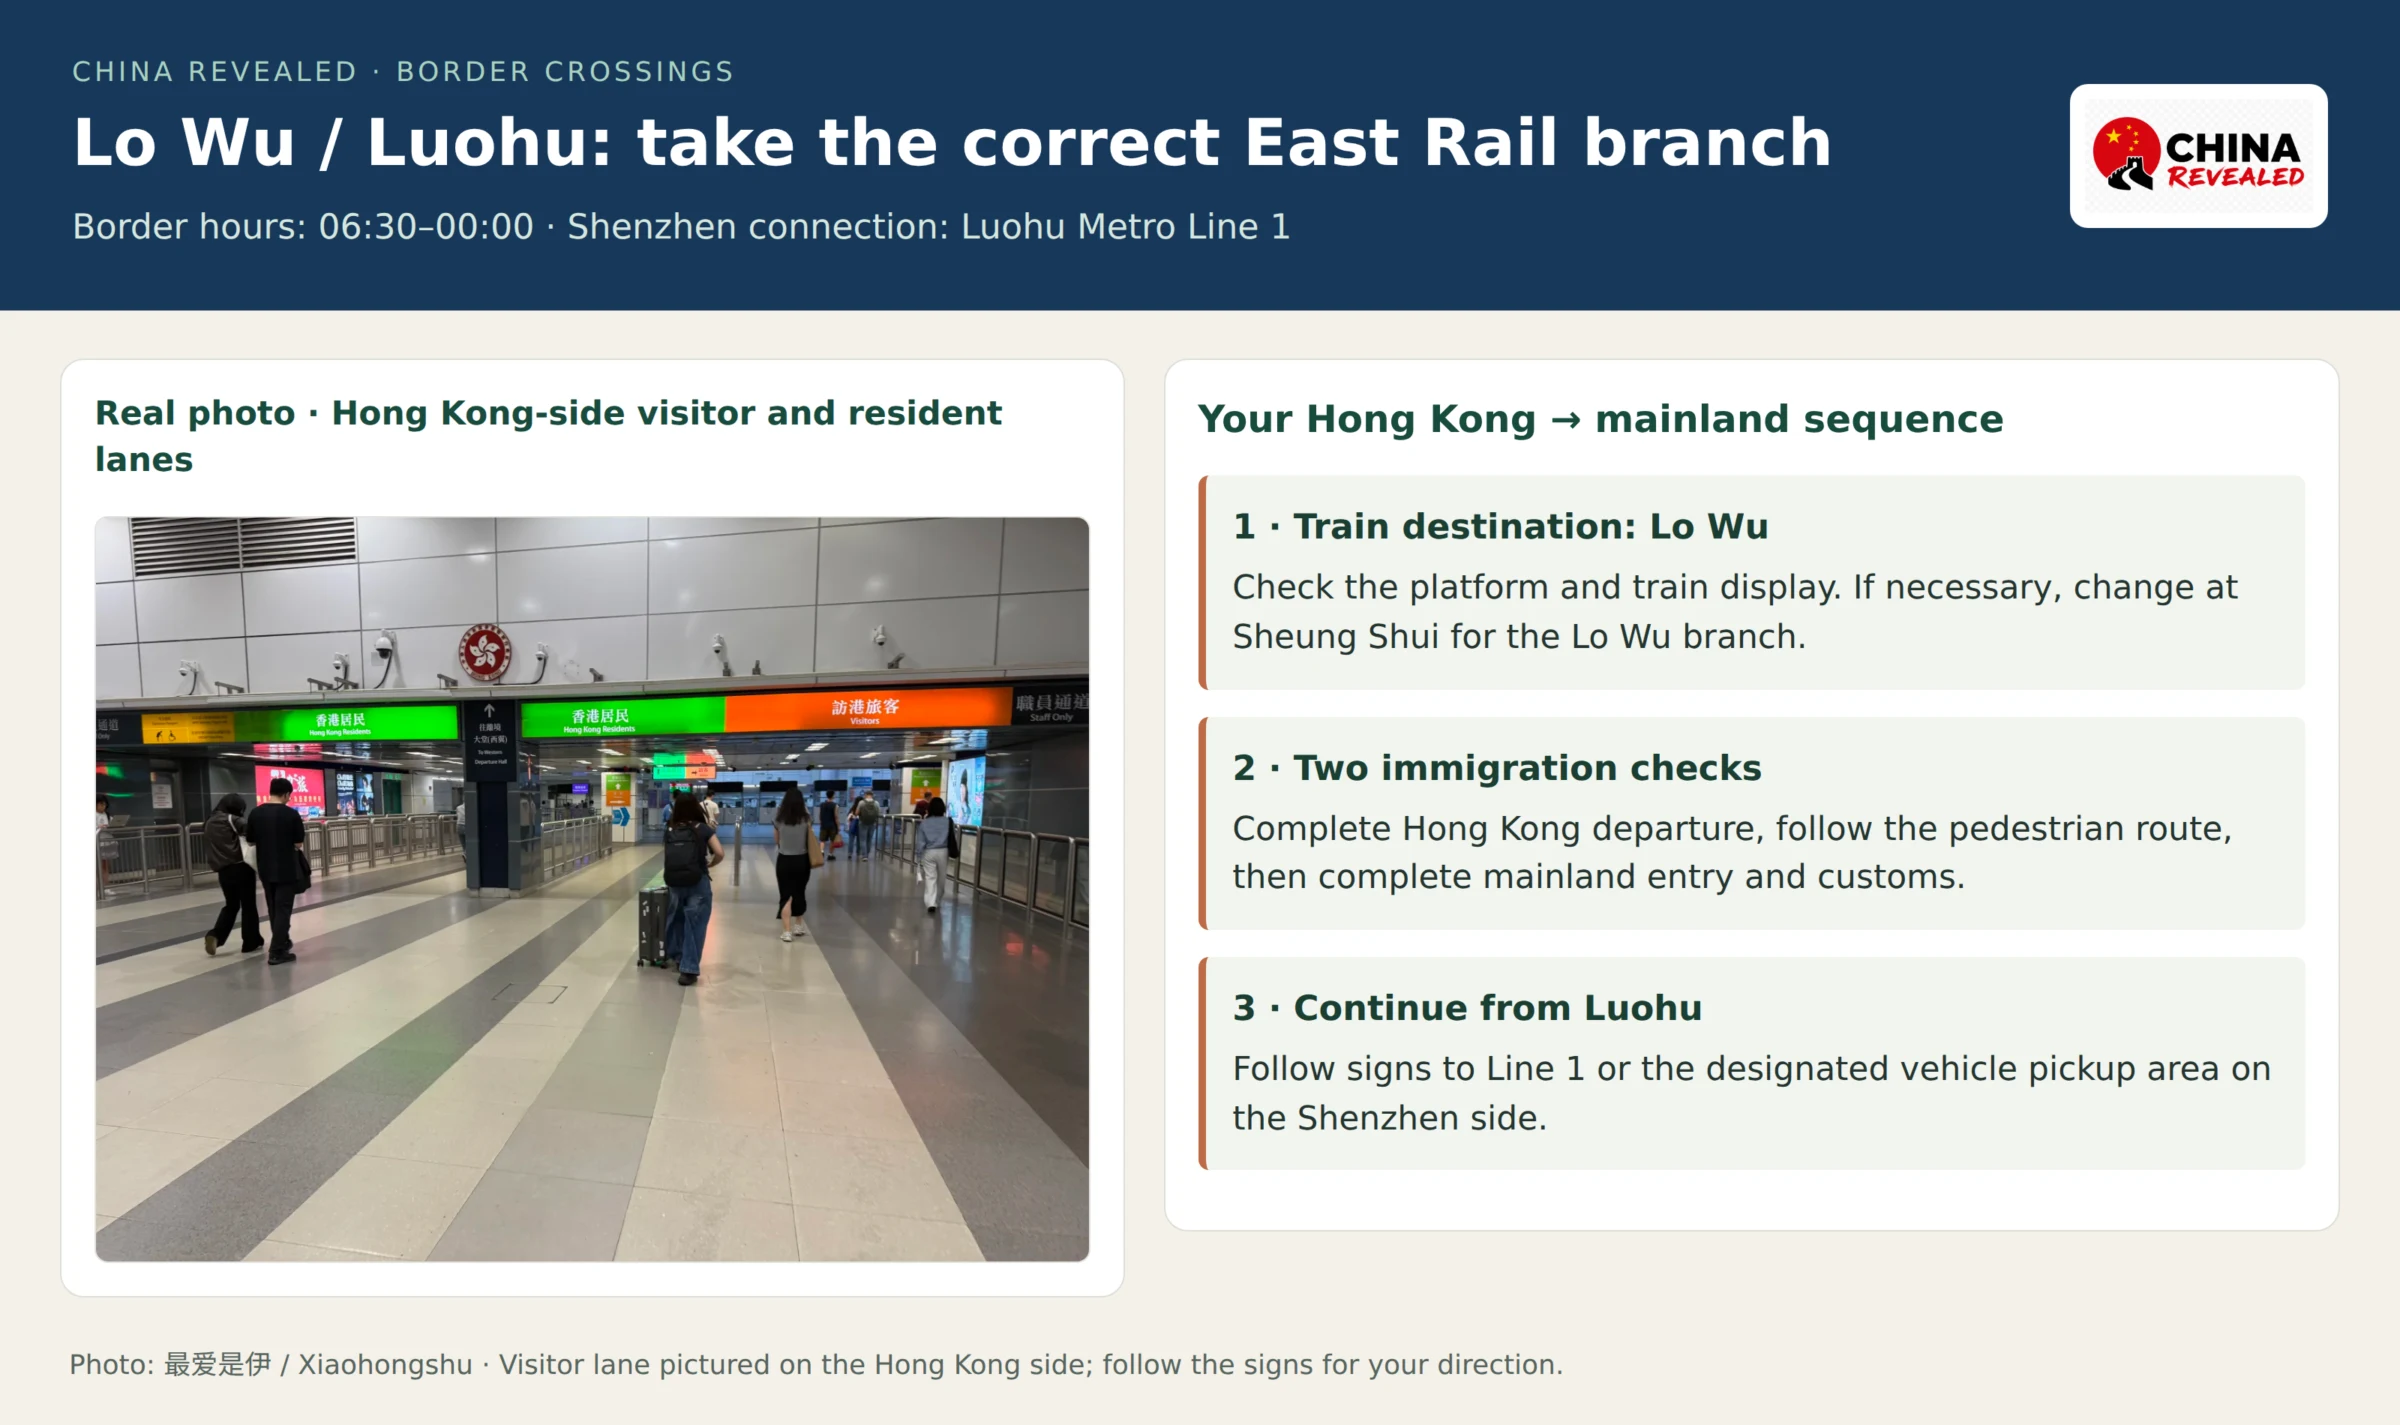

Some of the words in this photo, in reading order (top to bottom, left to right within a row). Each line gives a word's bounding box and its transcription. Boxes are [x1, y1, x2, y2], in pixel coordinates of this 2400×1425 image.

[831, 698, 900, 716] 訪港旅客
[1016, 693, 1090, 711] 職員通道
[315, 712, 366, 728] 香港居民
[572, 708, 629, 724] 香港居民
[850, 716, 880, 725] Visitors
[1030, 713, 1051, 722] Staff
[1052, 713, 1074, 723] Only
[309, 729, 326, 738] Hong
[326, 729, 342, 737] Kong
[342, 728, 371, 736] Residents
[563, 726, 582, 735] Hong
[583, 726, 601, 735] Kong
[602, 725, 636, 733] Residents
